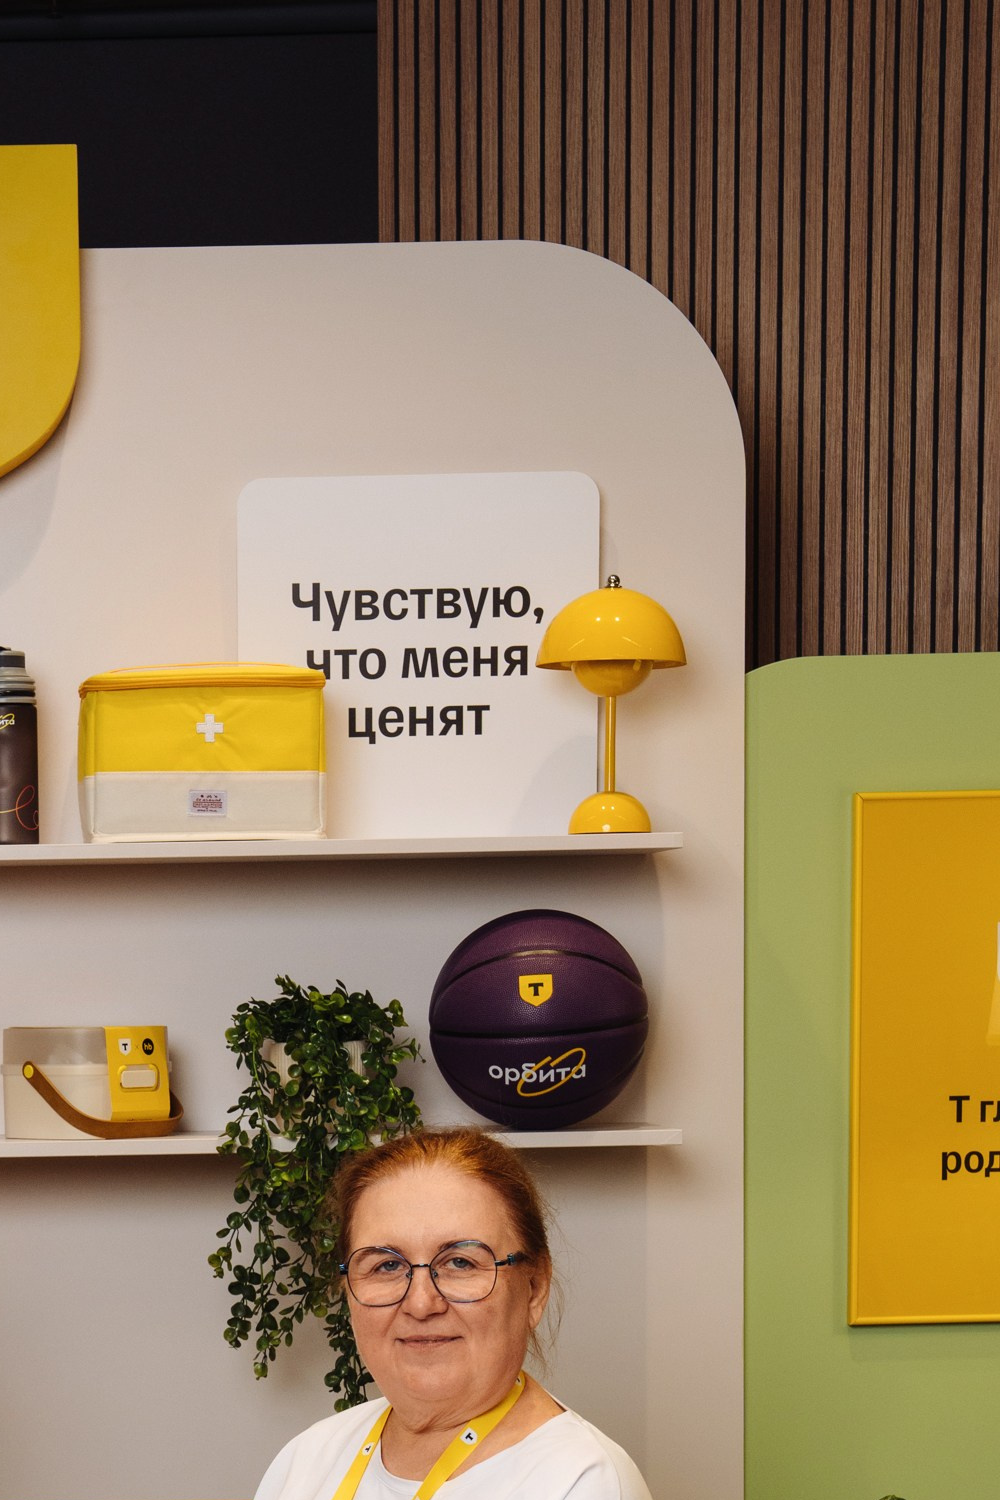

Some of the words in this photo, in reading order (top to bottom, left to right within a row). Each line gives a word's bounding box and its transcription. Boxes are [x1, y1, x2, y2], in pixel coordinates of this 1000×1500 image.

[291, 582, 544, 631] Чувствую,
[306, 648, 387, 680] что
[401, 645, 529, 679] меня
[348, 704, 491, 745] ценят
[528, 982, 544, 997] Т
[122, 1042, 129, 1051] Т
[487, 1061, 587, 1086] орбита
[948, 1095, 971, 1123] Т
